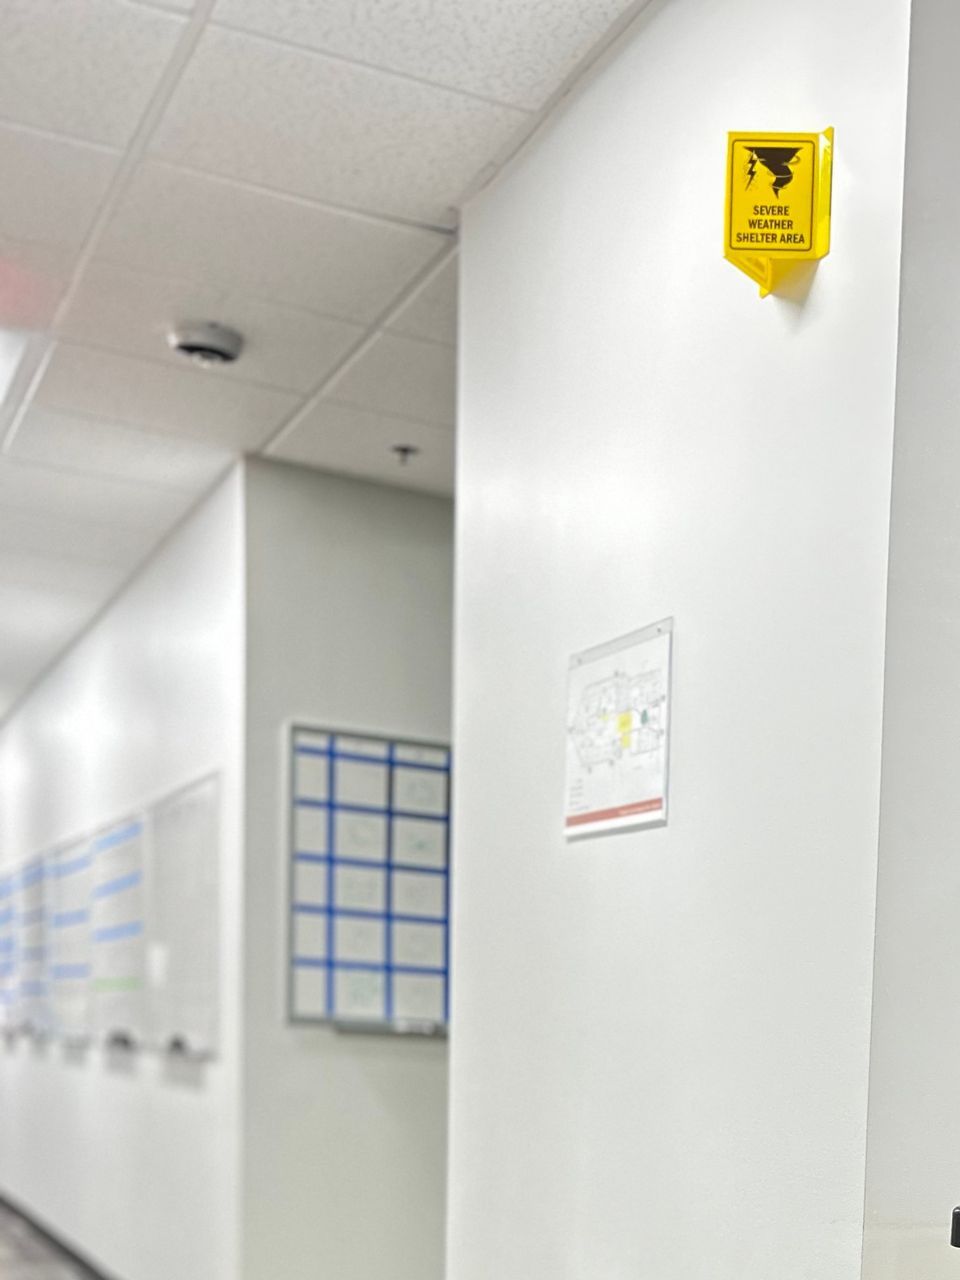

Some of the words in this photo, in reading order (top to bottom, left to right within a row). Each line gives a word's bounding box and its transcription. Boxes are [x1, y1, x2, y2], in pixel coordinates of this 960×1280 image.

[753, 205, 789, 216] SEVERE
[748, 219, 793, 230] WEATHER
[736, 232, 777, 243] SHELTER
[780, 233, 805, 244] AREA
